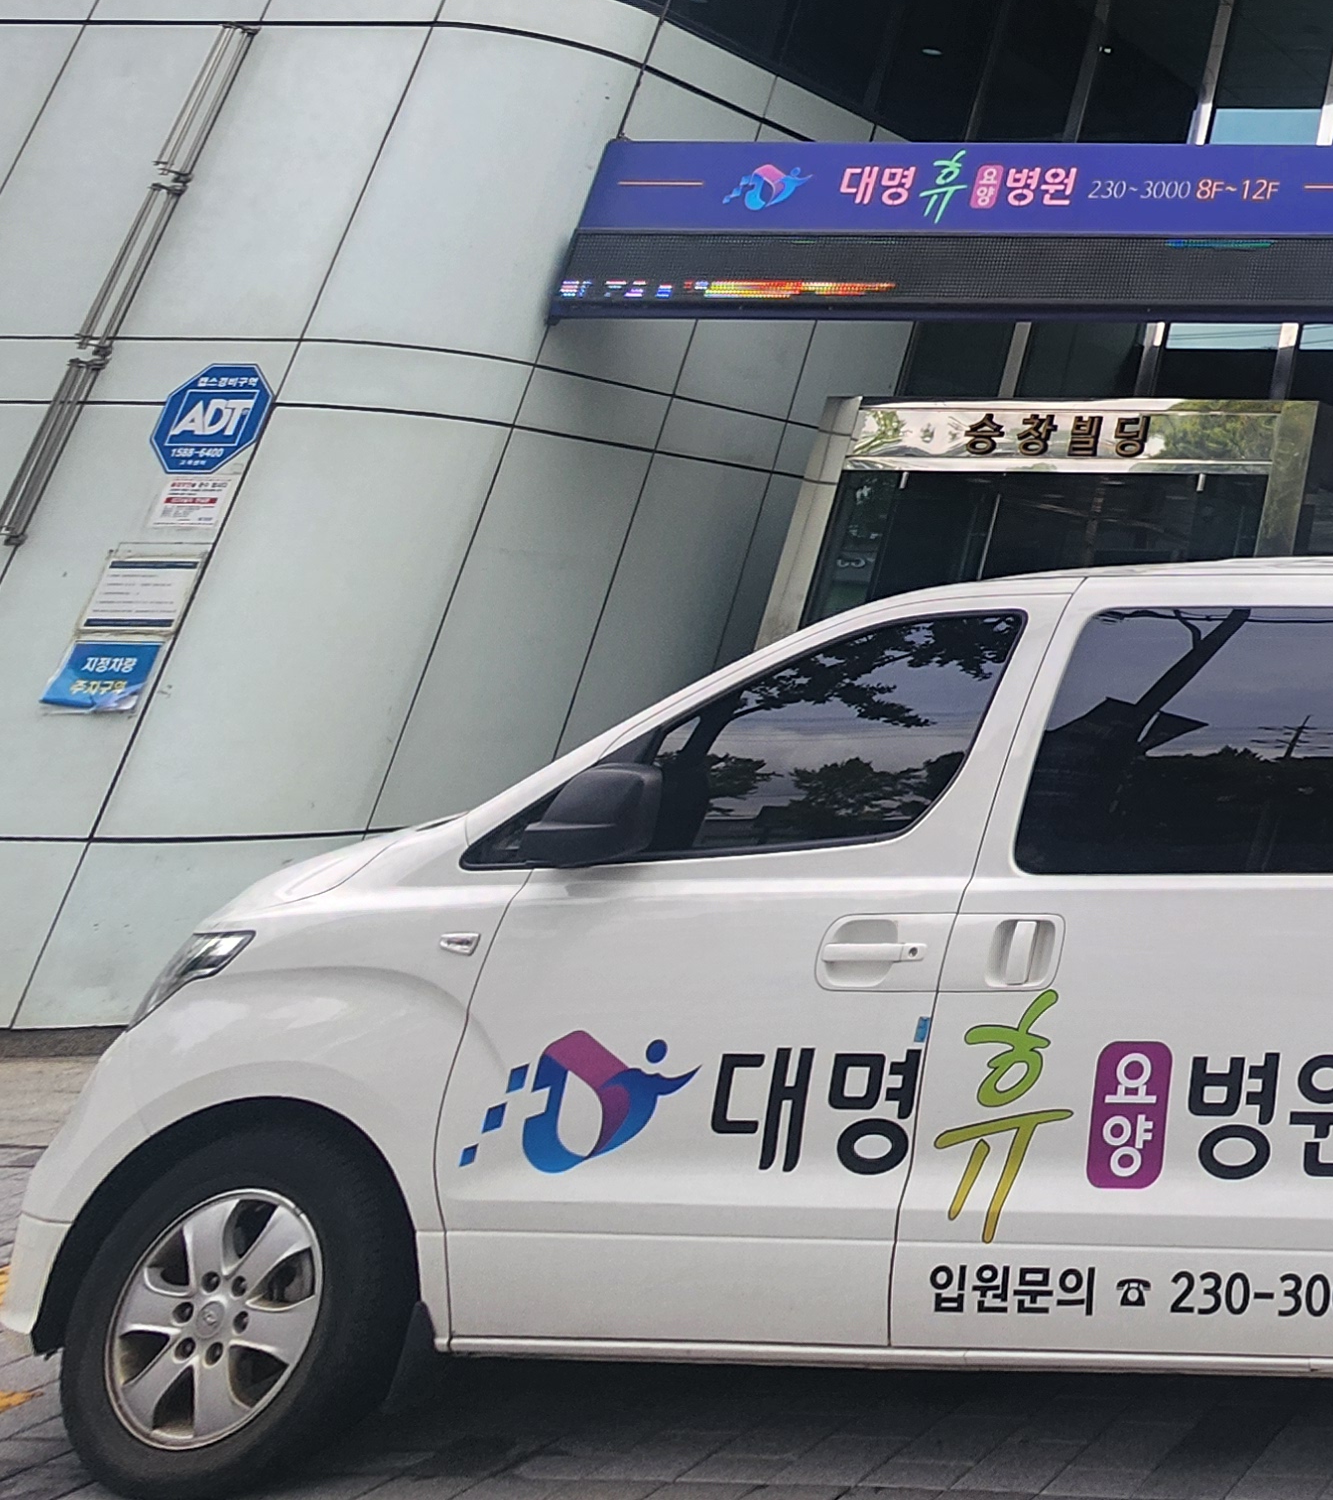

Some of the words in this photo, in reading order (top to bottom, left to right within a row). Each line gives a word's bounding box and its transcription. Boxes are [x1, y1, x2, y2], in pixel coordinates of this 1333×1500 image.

[839, 165, 917, 206] 대명
[918, 149, 968, 225] 휴
[975, 167, 999, 207] 요양
[1005, 164, 1078, 207] 병원
[1087, 180, 1191, 200] 230~3000
[1196, 178, 1281, 201] 8F~12F
[170, 398, 255, 436] ADT
[964, 412, 1151, 458] 승창빌딩
[81, 655, 138, 674] 지정차량
[710, 1046, 924, 1175] 대명
[933, 989, 1074, 1244] 휴
[1101, 1050, 1157, 1181] 요양
[928, 1263, 1096, 1319] 입원문의
